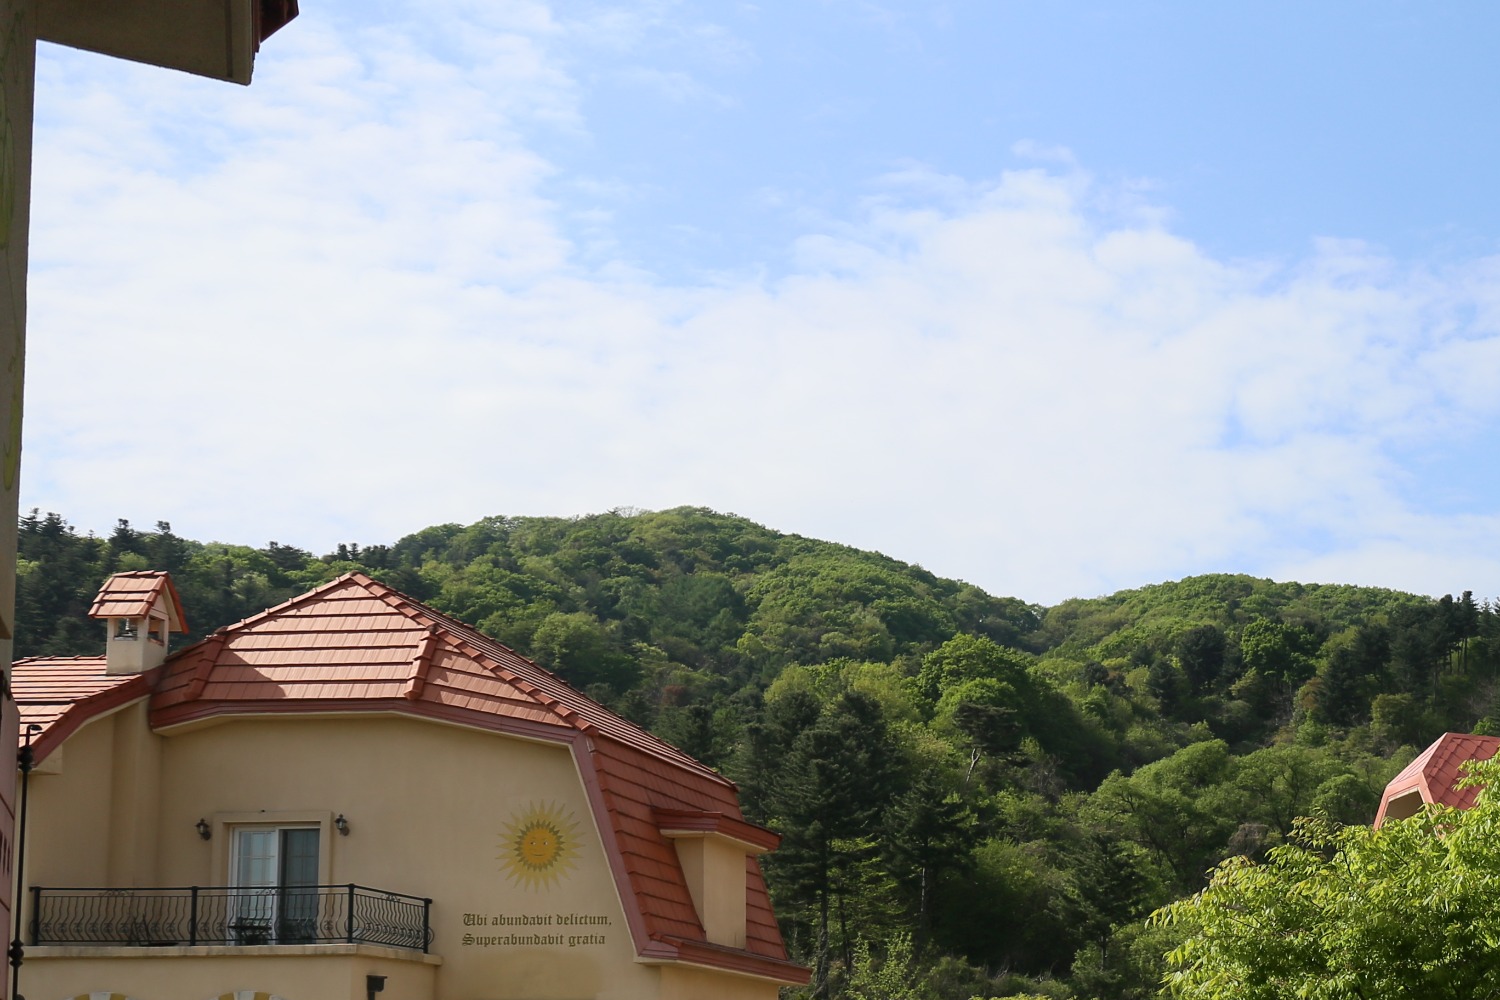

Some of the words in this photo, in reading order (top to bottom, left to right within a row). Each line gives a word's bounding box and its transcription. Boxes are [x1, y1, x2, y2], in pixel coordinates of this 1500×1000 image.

[463, 913, 487, 926] Ubi
[492, 913, 552, 926] abundavit
[556, 913, 612, 927] delictum,
[462, 933, 564, 947] Superabundavit
[568, 934, 606, 947] gratia
